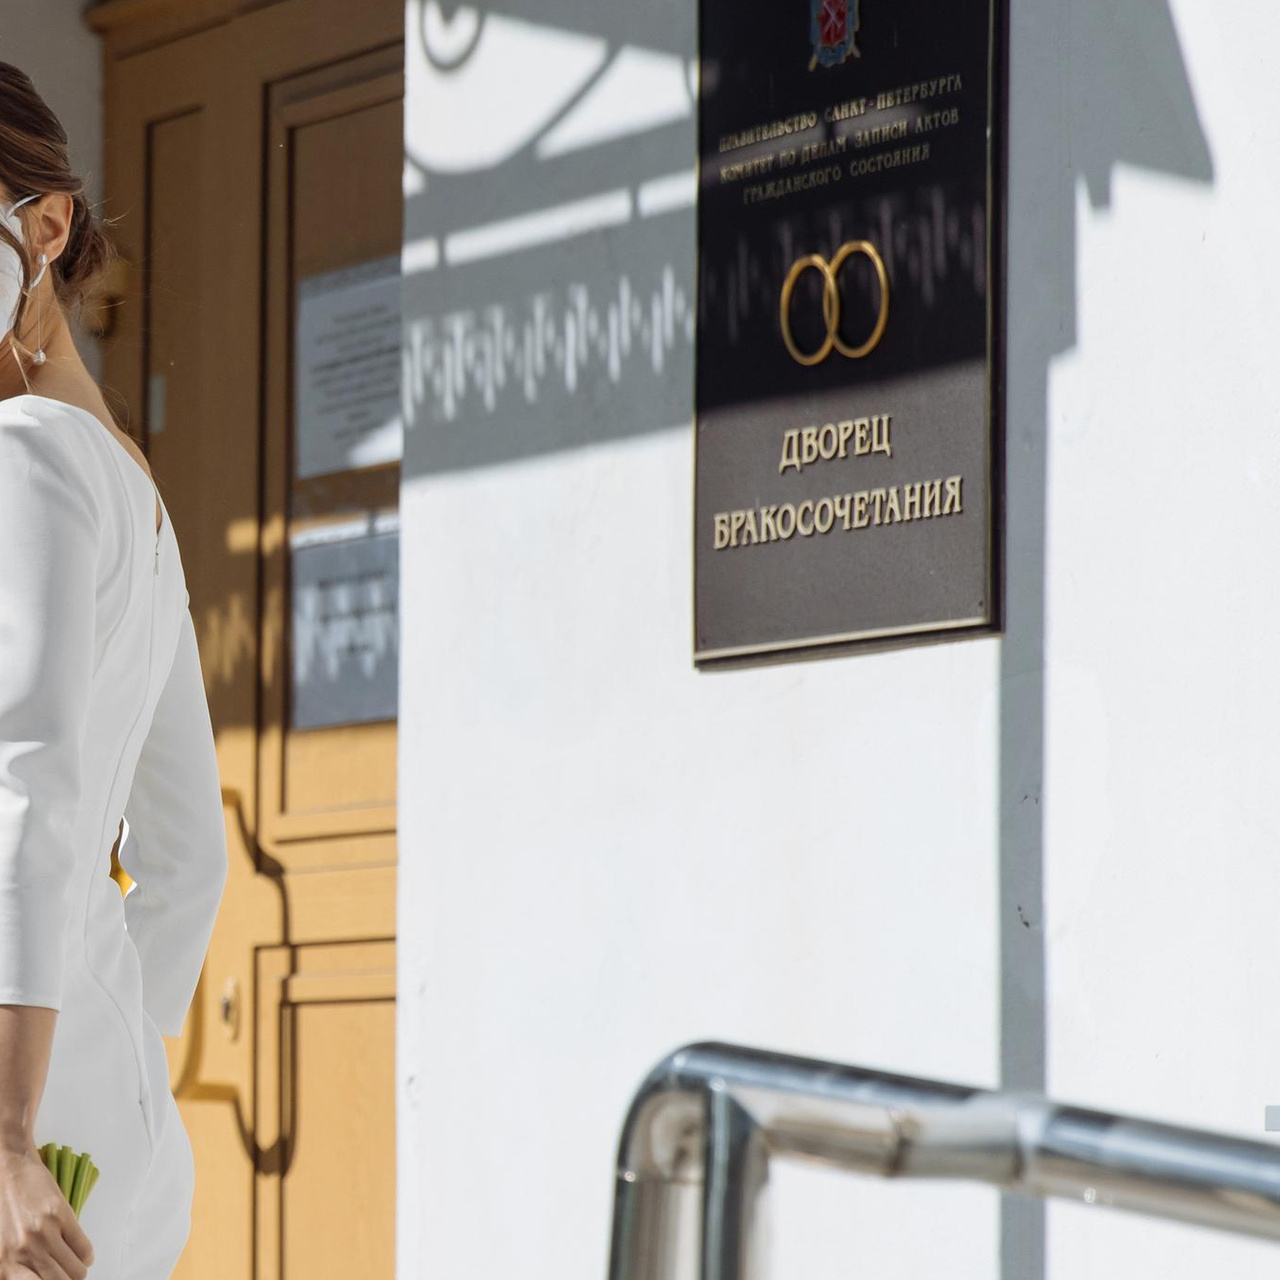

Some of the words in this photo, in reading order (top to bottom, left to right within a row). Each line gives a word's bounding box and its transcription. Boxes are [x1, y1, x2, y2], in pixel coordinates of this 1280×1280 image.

[780, 147, 797, 168] ПО
[801, 136, 846, 166] ДЕЛАМ
[854, 121, 909, 149] ЗАПИСИ
[915, 108, 959, 134] АКТОВ
[743, 165, 842, 204] ГРАЖДАНСКОГО
[850, 143, 931, 177] СОСТОЯНИЯ
[778, 413, 892, 474] ДВОРЕЦ
[713, 474, 963, 550] БРАКОСОЧЕТАНИЯ
